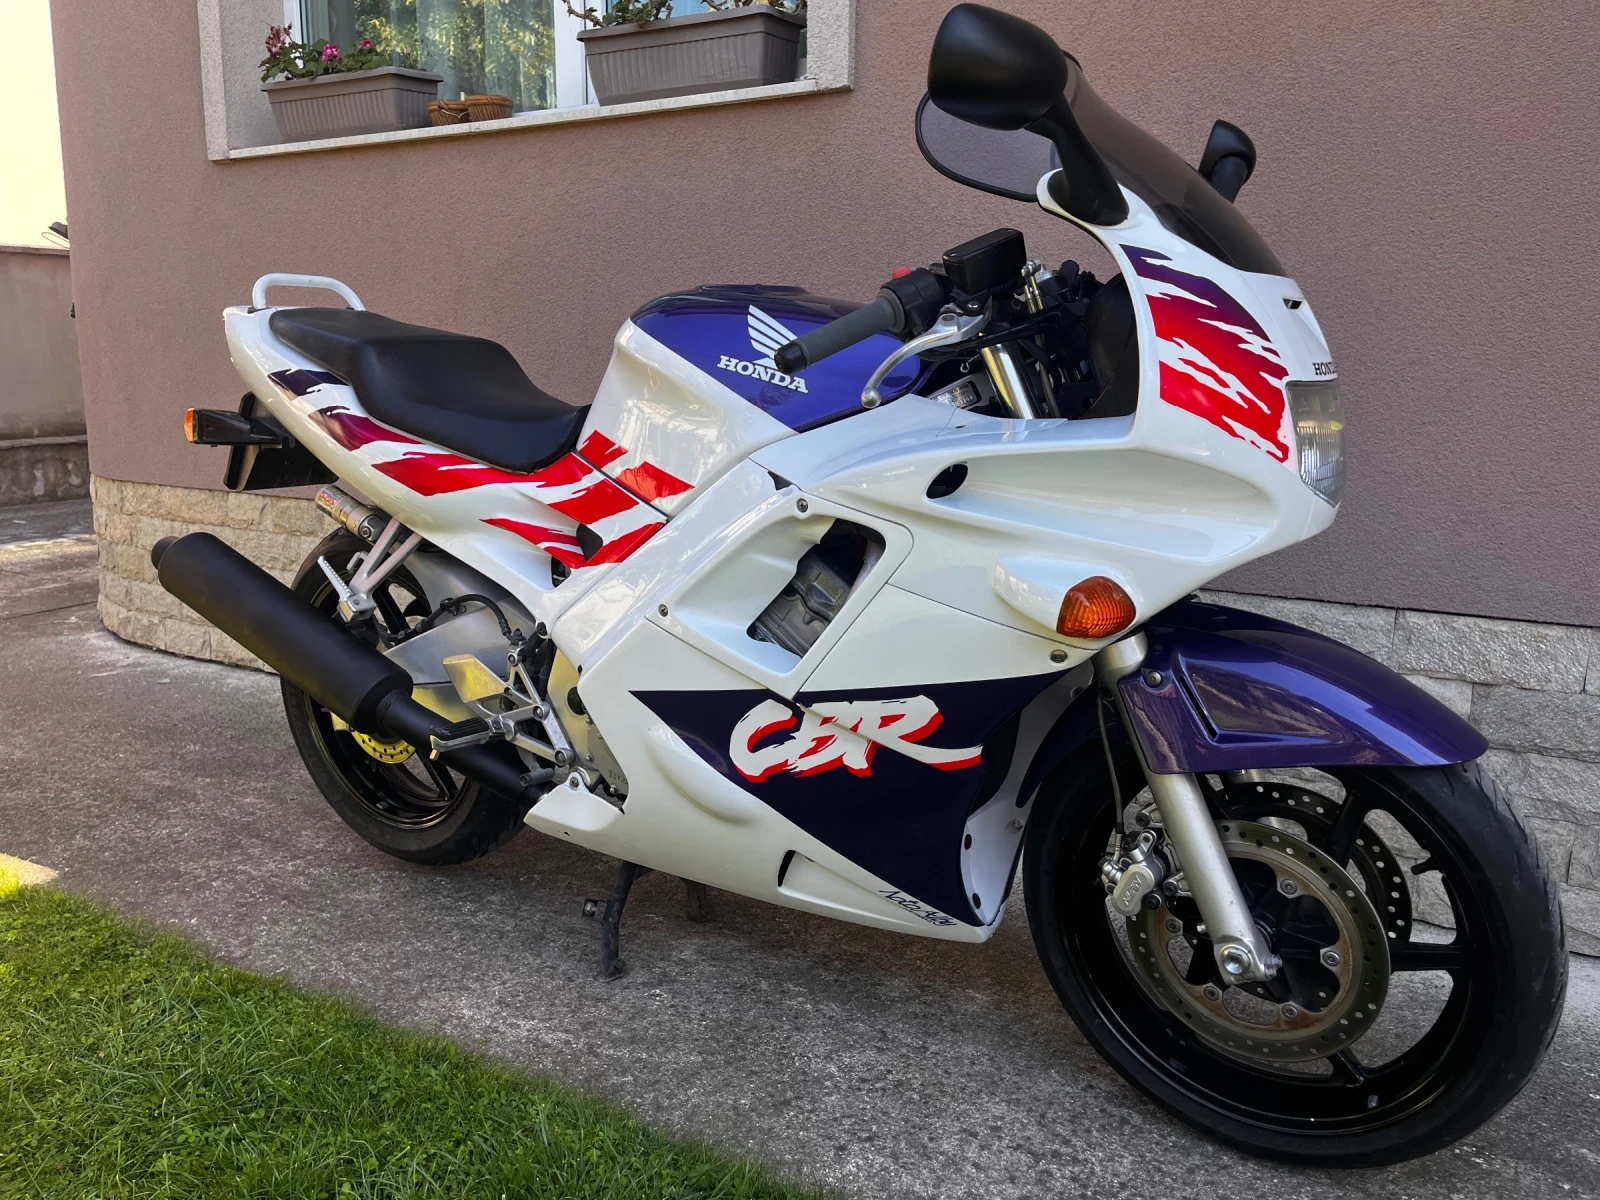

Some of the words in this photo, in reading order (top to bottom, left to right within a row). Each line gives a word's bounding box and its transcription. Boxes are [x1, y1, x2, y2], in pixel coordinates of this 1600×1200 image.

[717, 355, 809, 394] HONDA
[1312, 361, 1335, 376] HON
[729, 694, 984, 783] CBR
